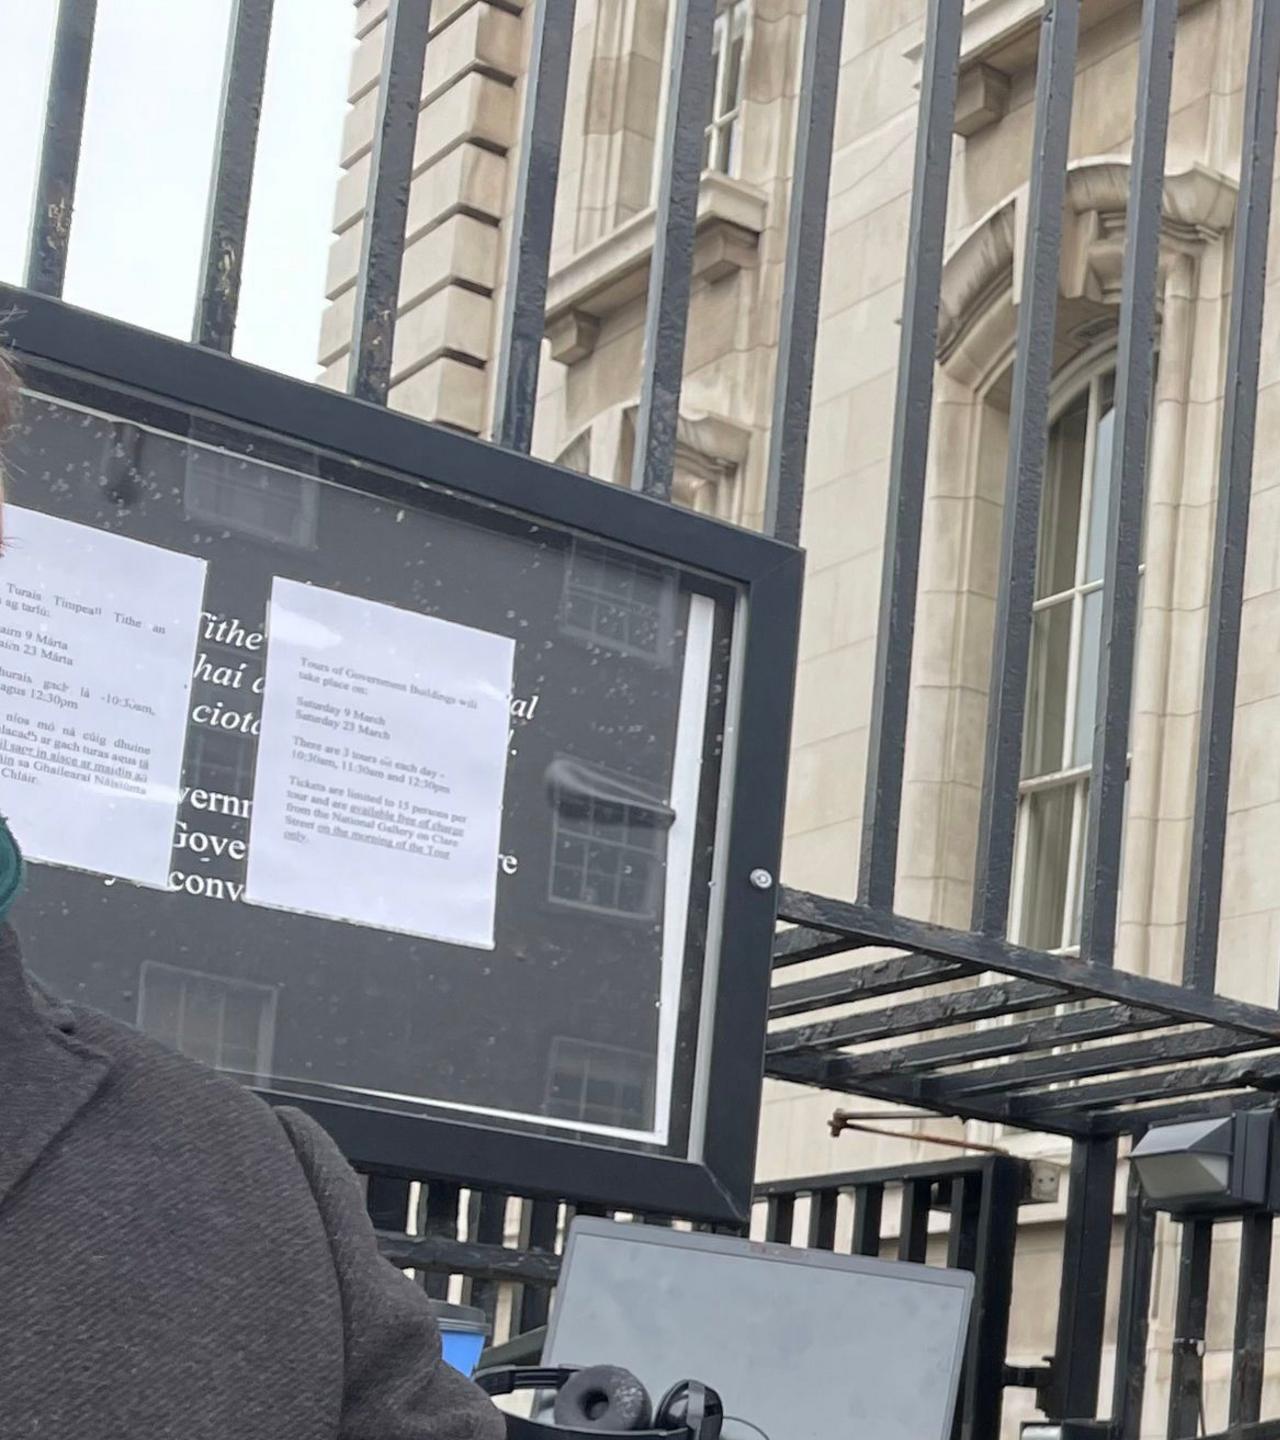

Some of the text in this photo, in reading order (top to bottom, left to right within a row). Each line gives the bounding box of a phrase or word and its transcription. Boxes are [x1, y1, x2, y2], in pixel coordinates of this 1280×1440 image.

[113, 612, 142, 628] Tithe
[152, 625, 166, 635] an
[23, 643, 37, 656] 23
[40, 647, 74, 666] Márta
[24, 631, 33, 640] 9
[36, 632, 69, 650] Márta
[298, 671, 321, 685] take
[322, 676, 349, 691] place
[300, 656, 478, 710] Tours of Government Buildings will
[295, 709, 391, 741] Saturday 23 March
[296, 696, 386, 726] Saturday 9 March
[54, 739, 80, 753] gach
[113, 737, 151, 755] dhuine
[292, 735, 322, 750] There
[325, 743, 341, 755] are
[343, 748, 350, 758] 3
[352, 750, 378, 764] tours
[395, 761, 418, 774] each
[419, 767, 438, 780] day
[387, 772, 405, 784] and
[286, 789, 465, 838] tour and are available free of charge
[288, 775, 467, 824] Tickets are limited to 15 persons per
[284, 815, 450, 860] Street on the morning of the Tour
[286, 802, 459, 848] from the National Gallery on Clare
